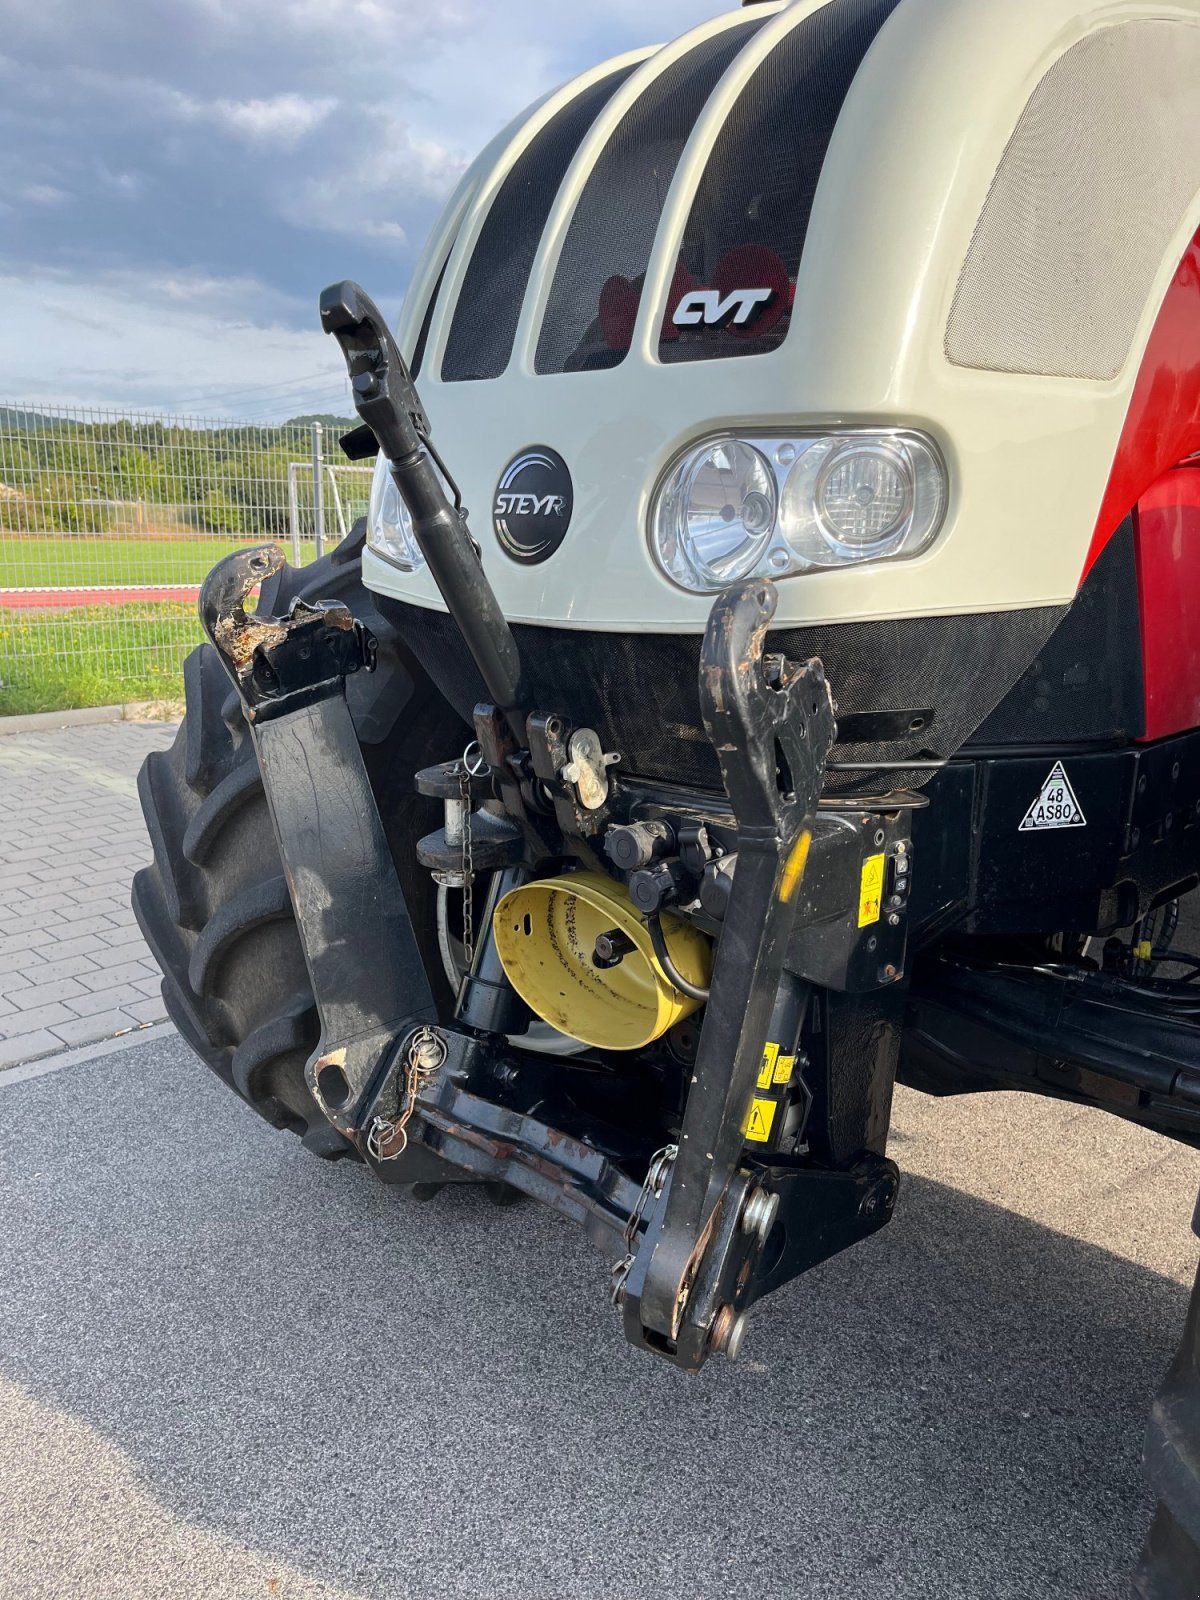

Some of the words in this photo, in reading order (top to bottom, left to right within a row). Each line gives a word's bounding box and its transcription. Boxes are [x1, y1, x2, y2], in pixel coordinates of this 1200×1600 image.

[672, 288, 772, 325] CVT
[494, 493, 567, 516] STEYR
[1047, 788, 1063, 803] 48
[1037, 804, 1071, 821] AS80
